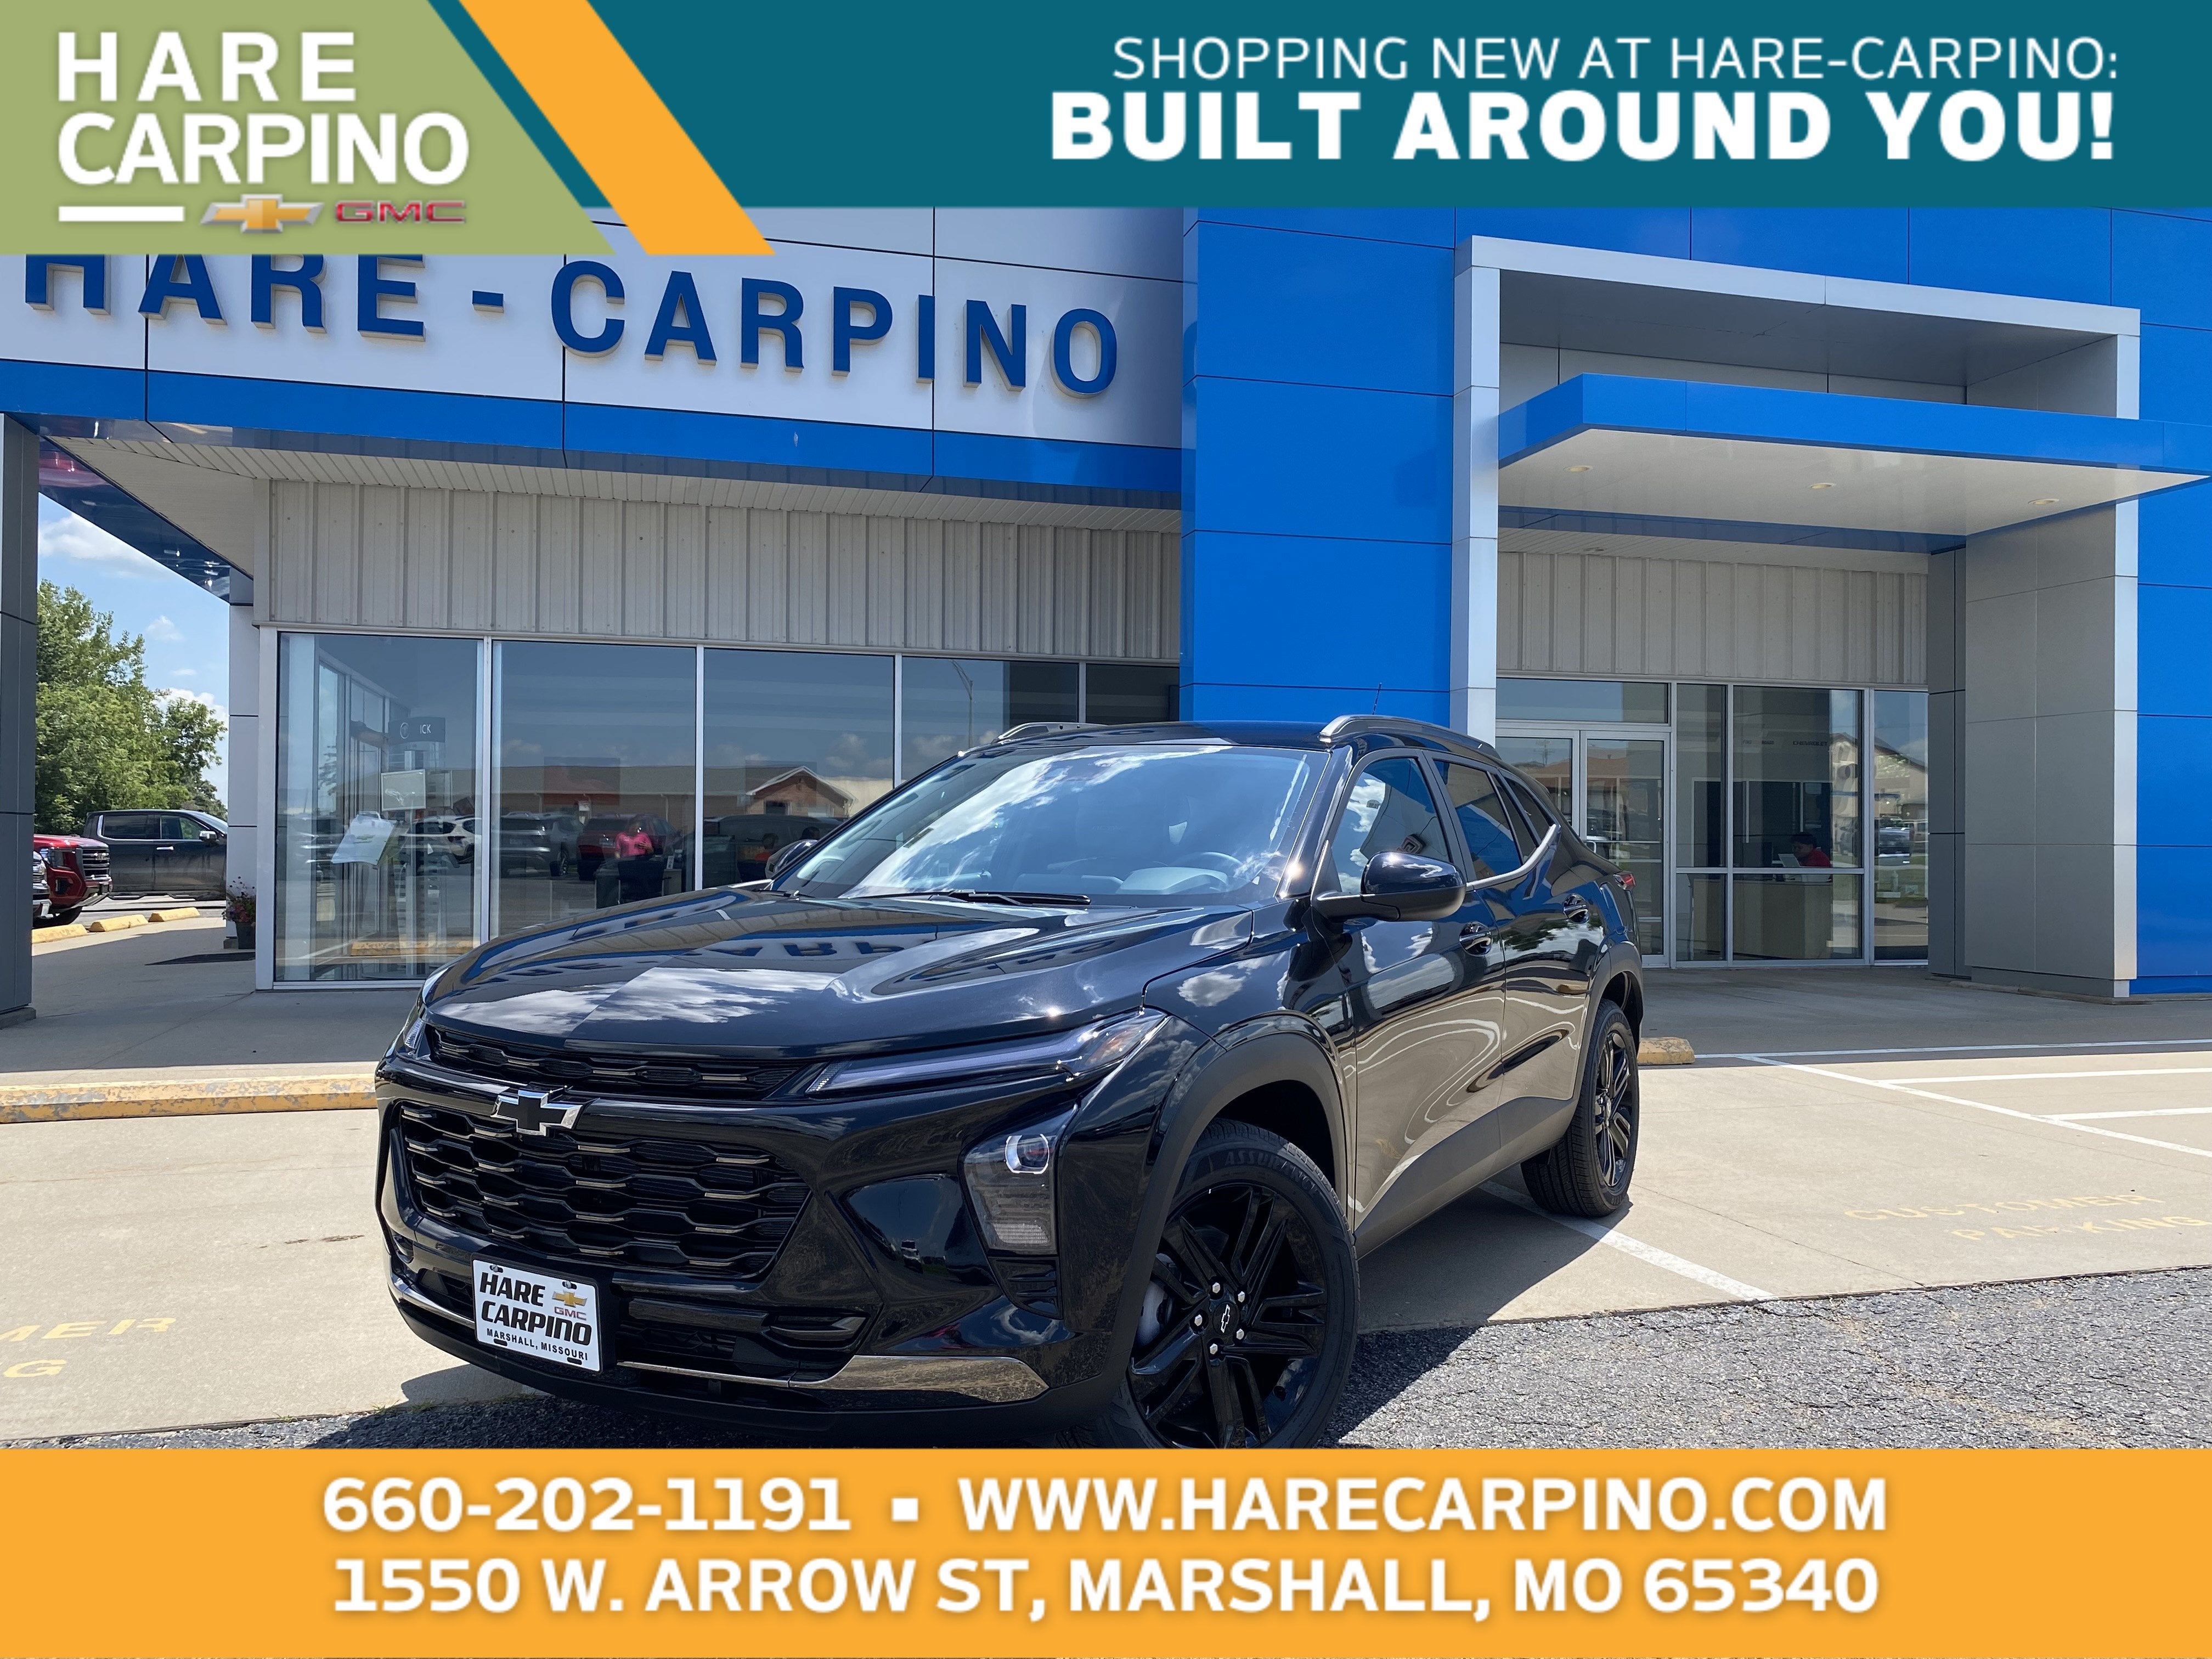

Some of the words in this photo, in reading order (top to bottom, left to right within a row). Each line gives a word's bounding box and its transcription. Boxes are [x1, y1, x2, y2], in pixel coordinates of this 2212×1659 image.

[551, 260, 1117, 396] CARPINO
[479, 1272, 546, 1307] HARE
[481, 1300, 592, 1346] CARPINO
[554, 1306, 587, 1321] GMC
[487, 1328, 538, 1351] MARSHALL,
[540, 1341, 589, 1361] MISSOURI
